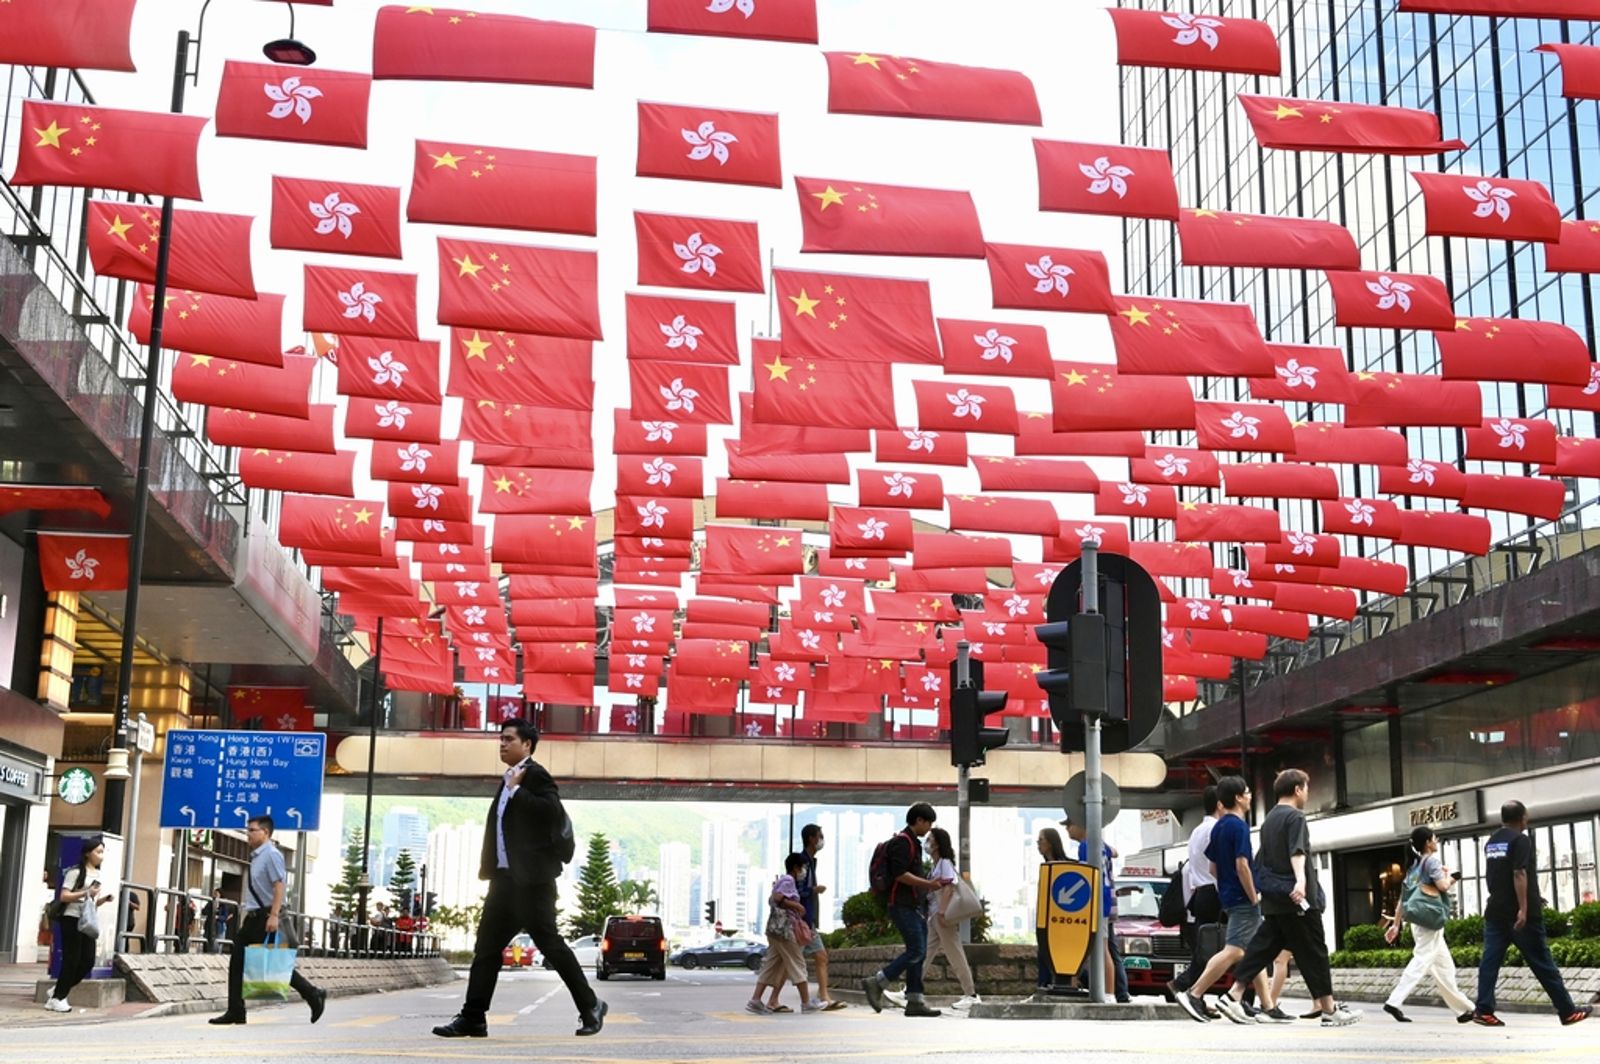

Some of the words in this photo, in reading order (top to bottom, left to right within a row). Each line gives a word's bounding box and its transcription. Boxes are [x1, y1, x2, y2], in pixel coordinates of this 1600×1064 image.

[173, 733, 194, 742] Hong
[198, 734, 219, 743] Kong
[228, 734, 249, 744] Hong
[253, 735, 274, 744] Kong
[277, 735, 294, 743] (W)
[173, 744, 195, 755] 香港
[228, 745, 272, 757] 香港(西)
[171, 756, 192, 764] Kwun
[198, 757, 216, 766] Tong
[226, 757, 247, 767] Hung
[250, 757, 269, 766] Hom
[273, 758, 289, 768] Bay
[6, 767, 28, 786] COFFEE
[171, 767, 193, 778] 觀塘
[239, 781, 257, 789] Kwa
[260, 781, 279, 790] Wan
[223, 792, 259, 802] 土瓜灣
